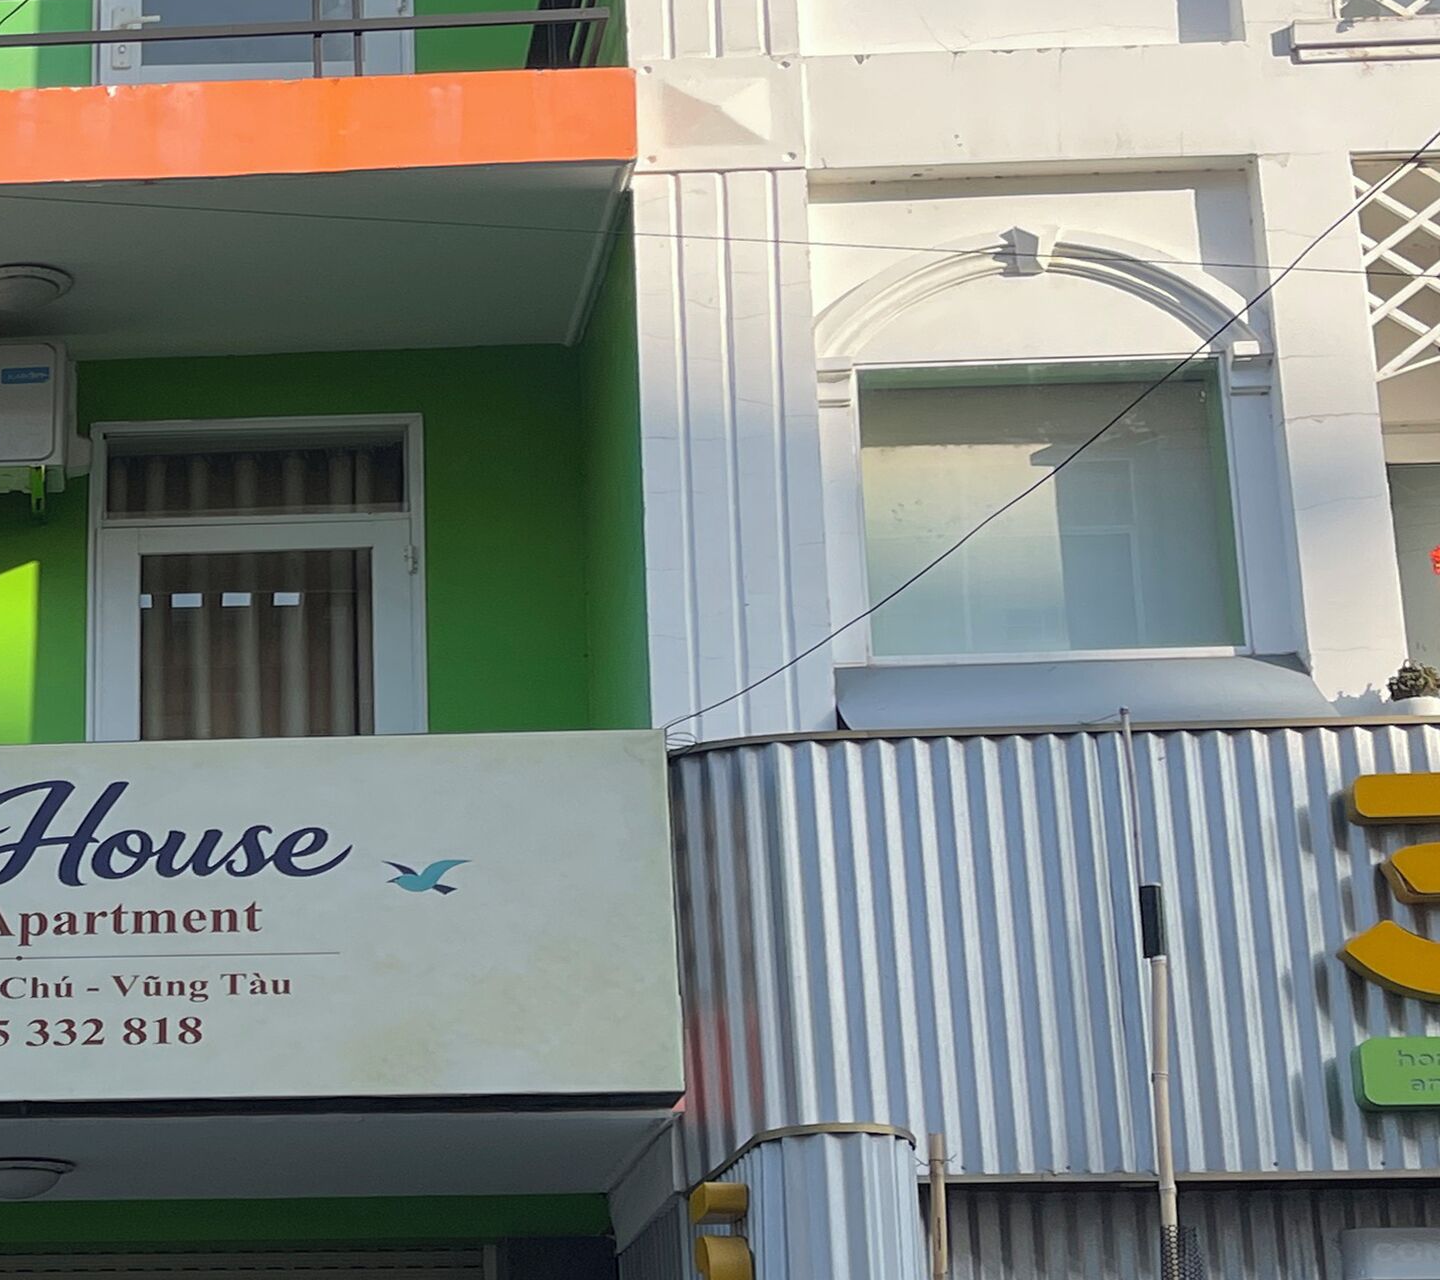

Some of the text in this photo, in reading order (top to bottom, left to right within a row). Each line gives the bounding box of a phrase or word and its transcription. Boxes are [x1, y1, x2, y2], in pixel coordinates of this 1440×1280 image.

[0, 975, 74, 1000] Chú
[112, 974, 209, 1003] Vũng
[220, 972, 291, 996] Tàu
[25, 1018, 105, 1047] 332
[122, 1016, 203, 1045] 818
